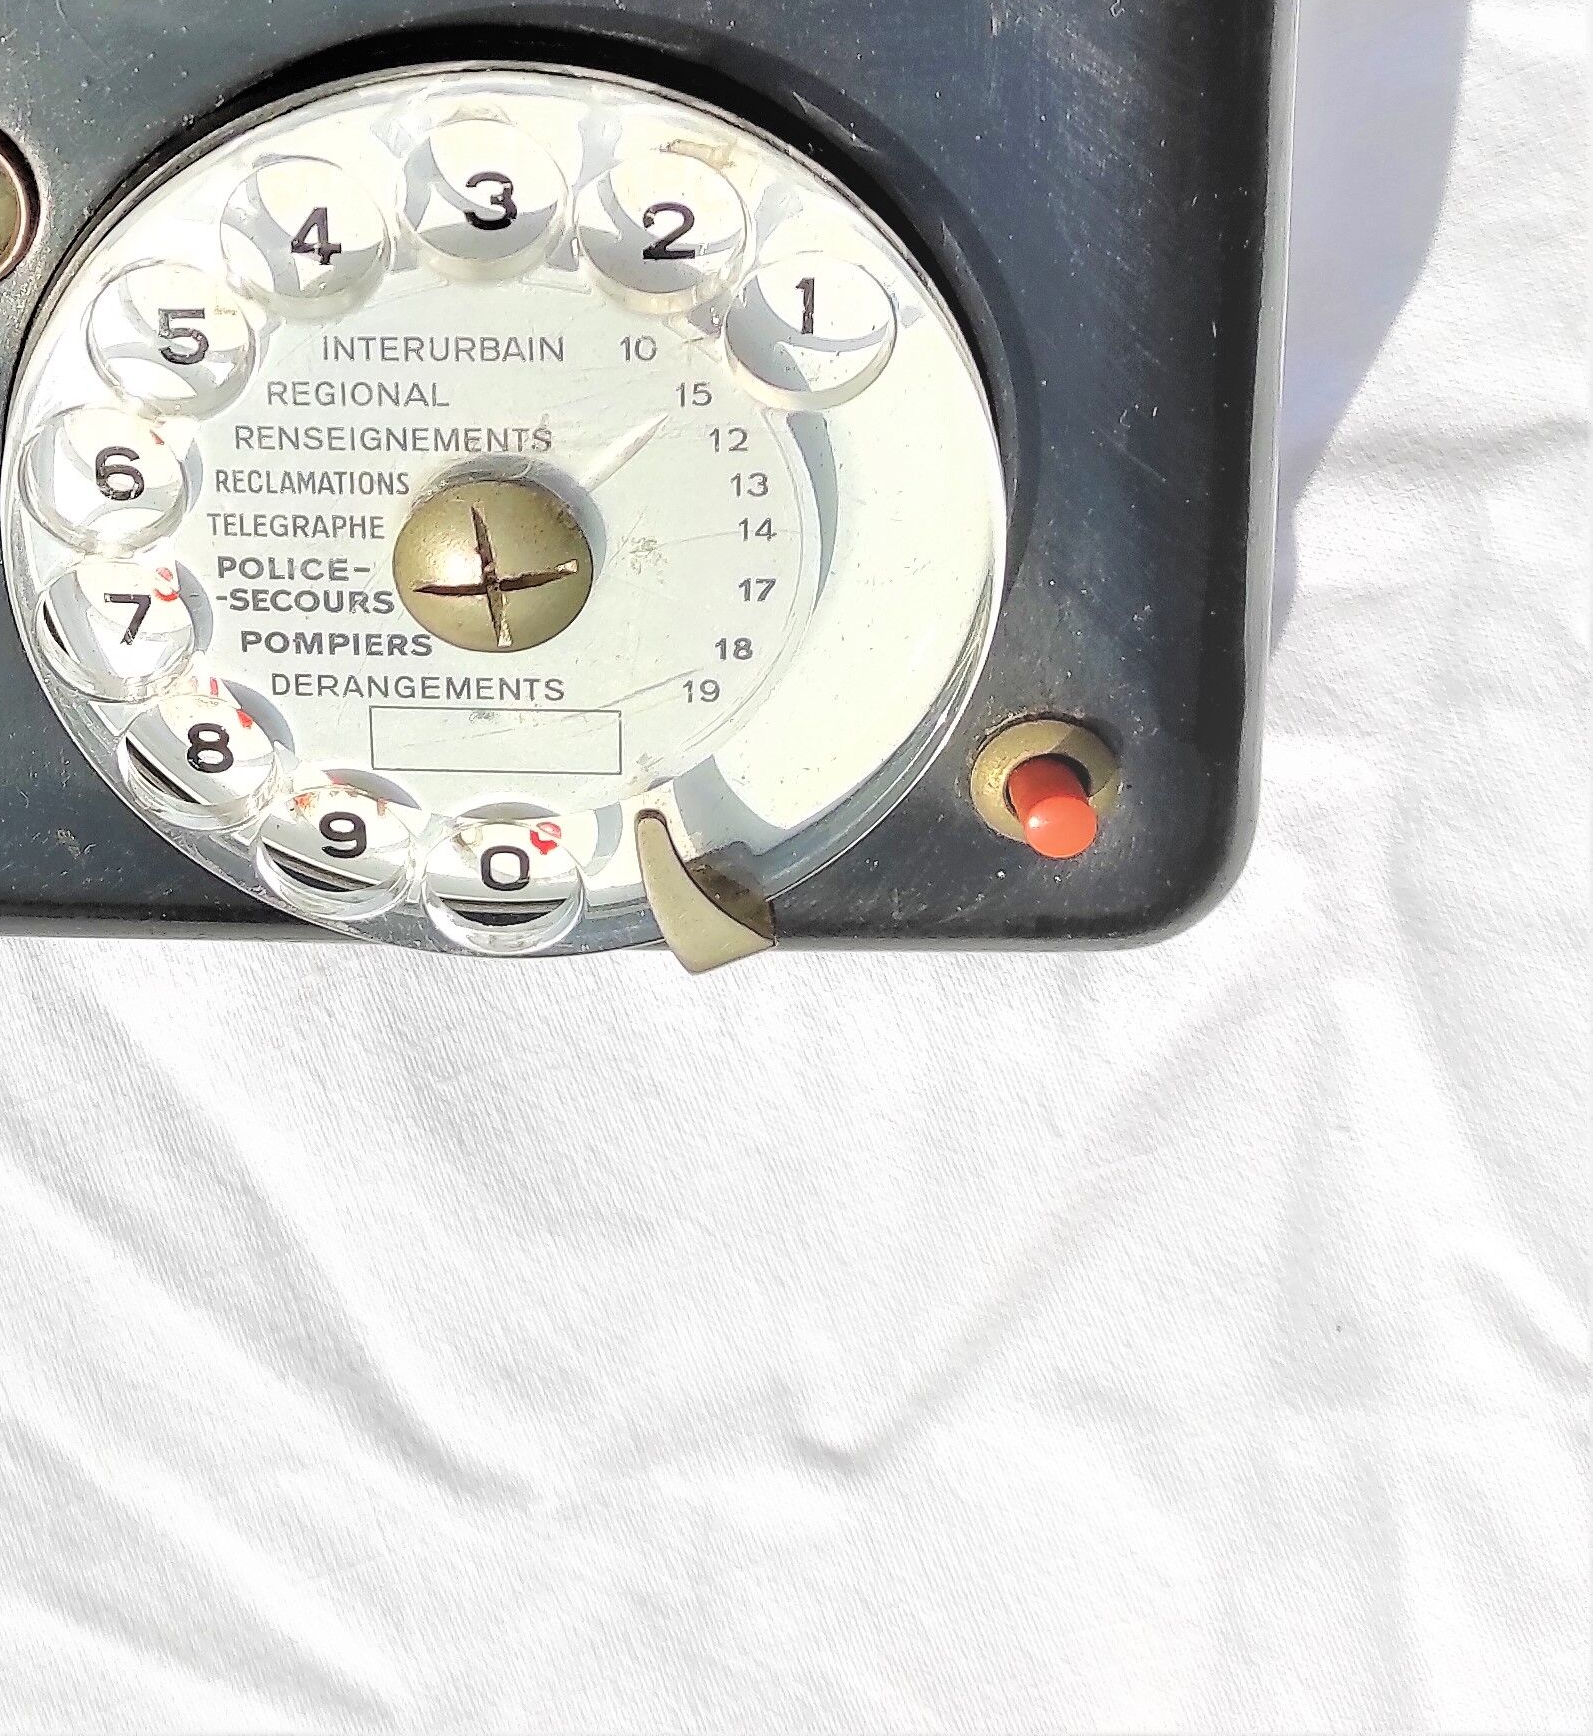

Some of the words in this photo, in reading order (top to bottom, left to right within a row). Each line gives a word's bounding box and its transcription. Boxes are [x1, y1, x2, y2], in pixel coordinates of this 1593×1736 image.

[464, 171, 518, 230] 3
[290, 206, 342, 265] 4
[642, 201, 696, 260] 2
[794, 276, 816, 335] 1
[157, 307, 210, 365] 5
[322, 335, 564, 362] INTERURBAIN
[619, 335, 658, 362] 10
[266, 380, 450, 407] REGIONAL
[675, 381, 713, 407] 15
[234, 425, 553, 453] RENSEIGNEMENTS
[708, 427, 749, 453] 12
[95, 446, 145, 501] 6
[215, 469, 410, 496] RECLAMATIONS
[729, 472, 770, 497] 13
[207, 513, 386, 539] TELEGRAPHE
[738, 517, 777, 542] 14
[216, 555, 371, 582] POLICE-
[215, 587, 396, 615] -SECOURS
[738, 578, 777, 602] 17
[104, 592, 152, 646] 7
[240, 630, 434, 657] POMPIERS
[714, 637, 754, 661] 18
[271, 673, 566, 702] DERANGEMENTS
[682, 679, 721, 704] 19
[186, 722, 235, 774] 8
[319, 811, 367, 859] 9
